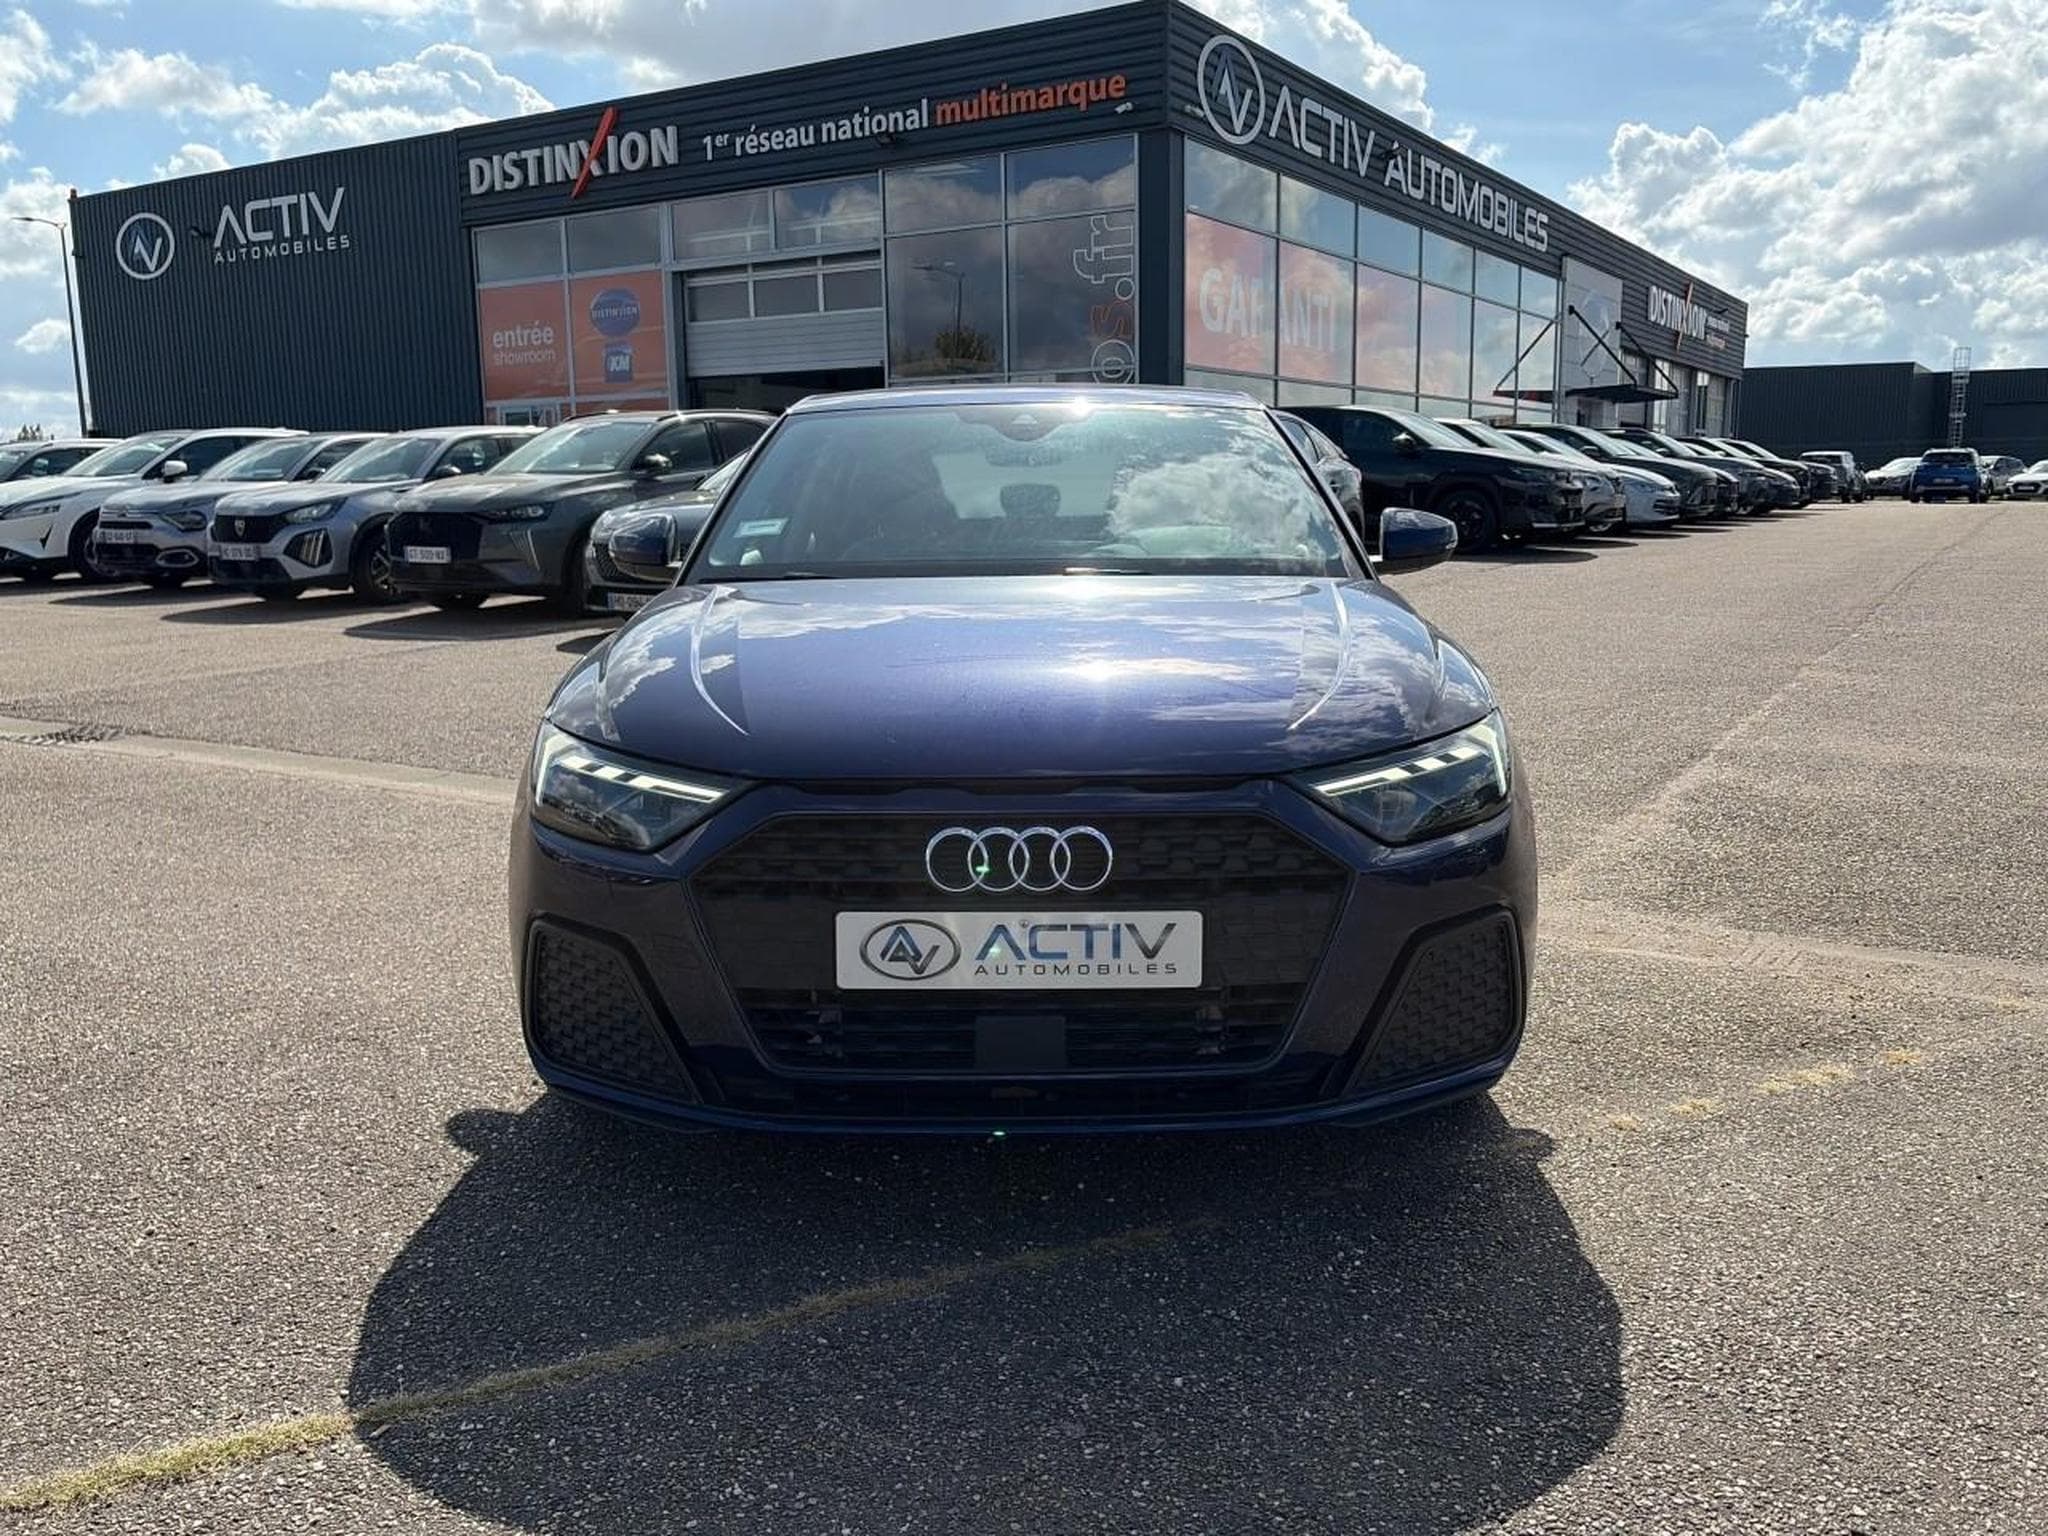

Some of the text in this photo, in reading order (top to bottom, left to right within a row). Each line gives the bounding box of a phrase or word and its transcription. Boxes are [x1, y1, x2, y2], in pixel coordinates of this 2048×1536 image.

[735, 123, 816, 158] réseau
[821, 98, 929, 144] national
[935, 73, 1127, 127] multimarque
[468, 106, 680, 199] DISTINXION
[1268, 84, 1550, 253] ACTIV AUTOMOBILES
[213, 186, 345, 249] ACTIV
[213, 233, 351, 266] AUTOMOBILES
[492, 319, 554, 348] entrée
[494, 348, 557, 366] showroom
[974, 922, 1178, 961] ACTIV
[974, 962, 1178, 977] AUTOMOBILES
